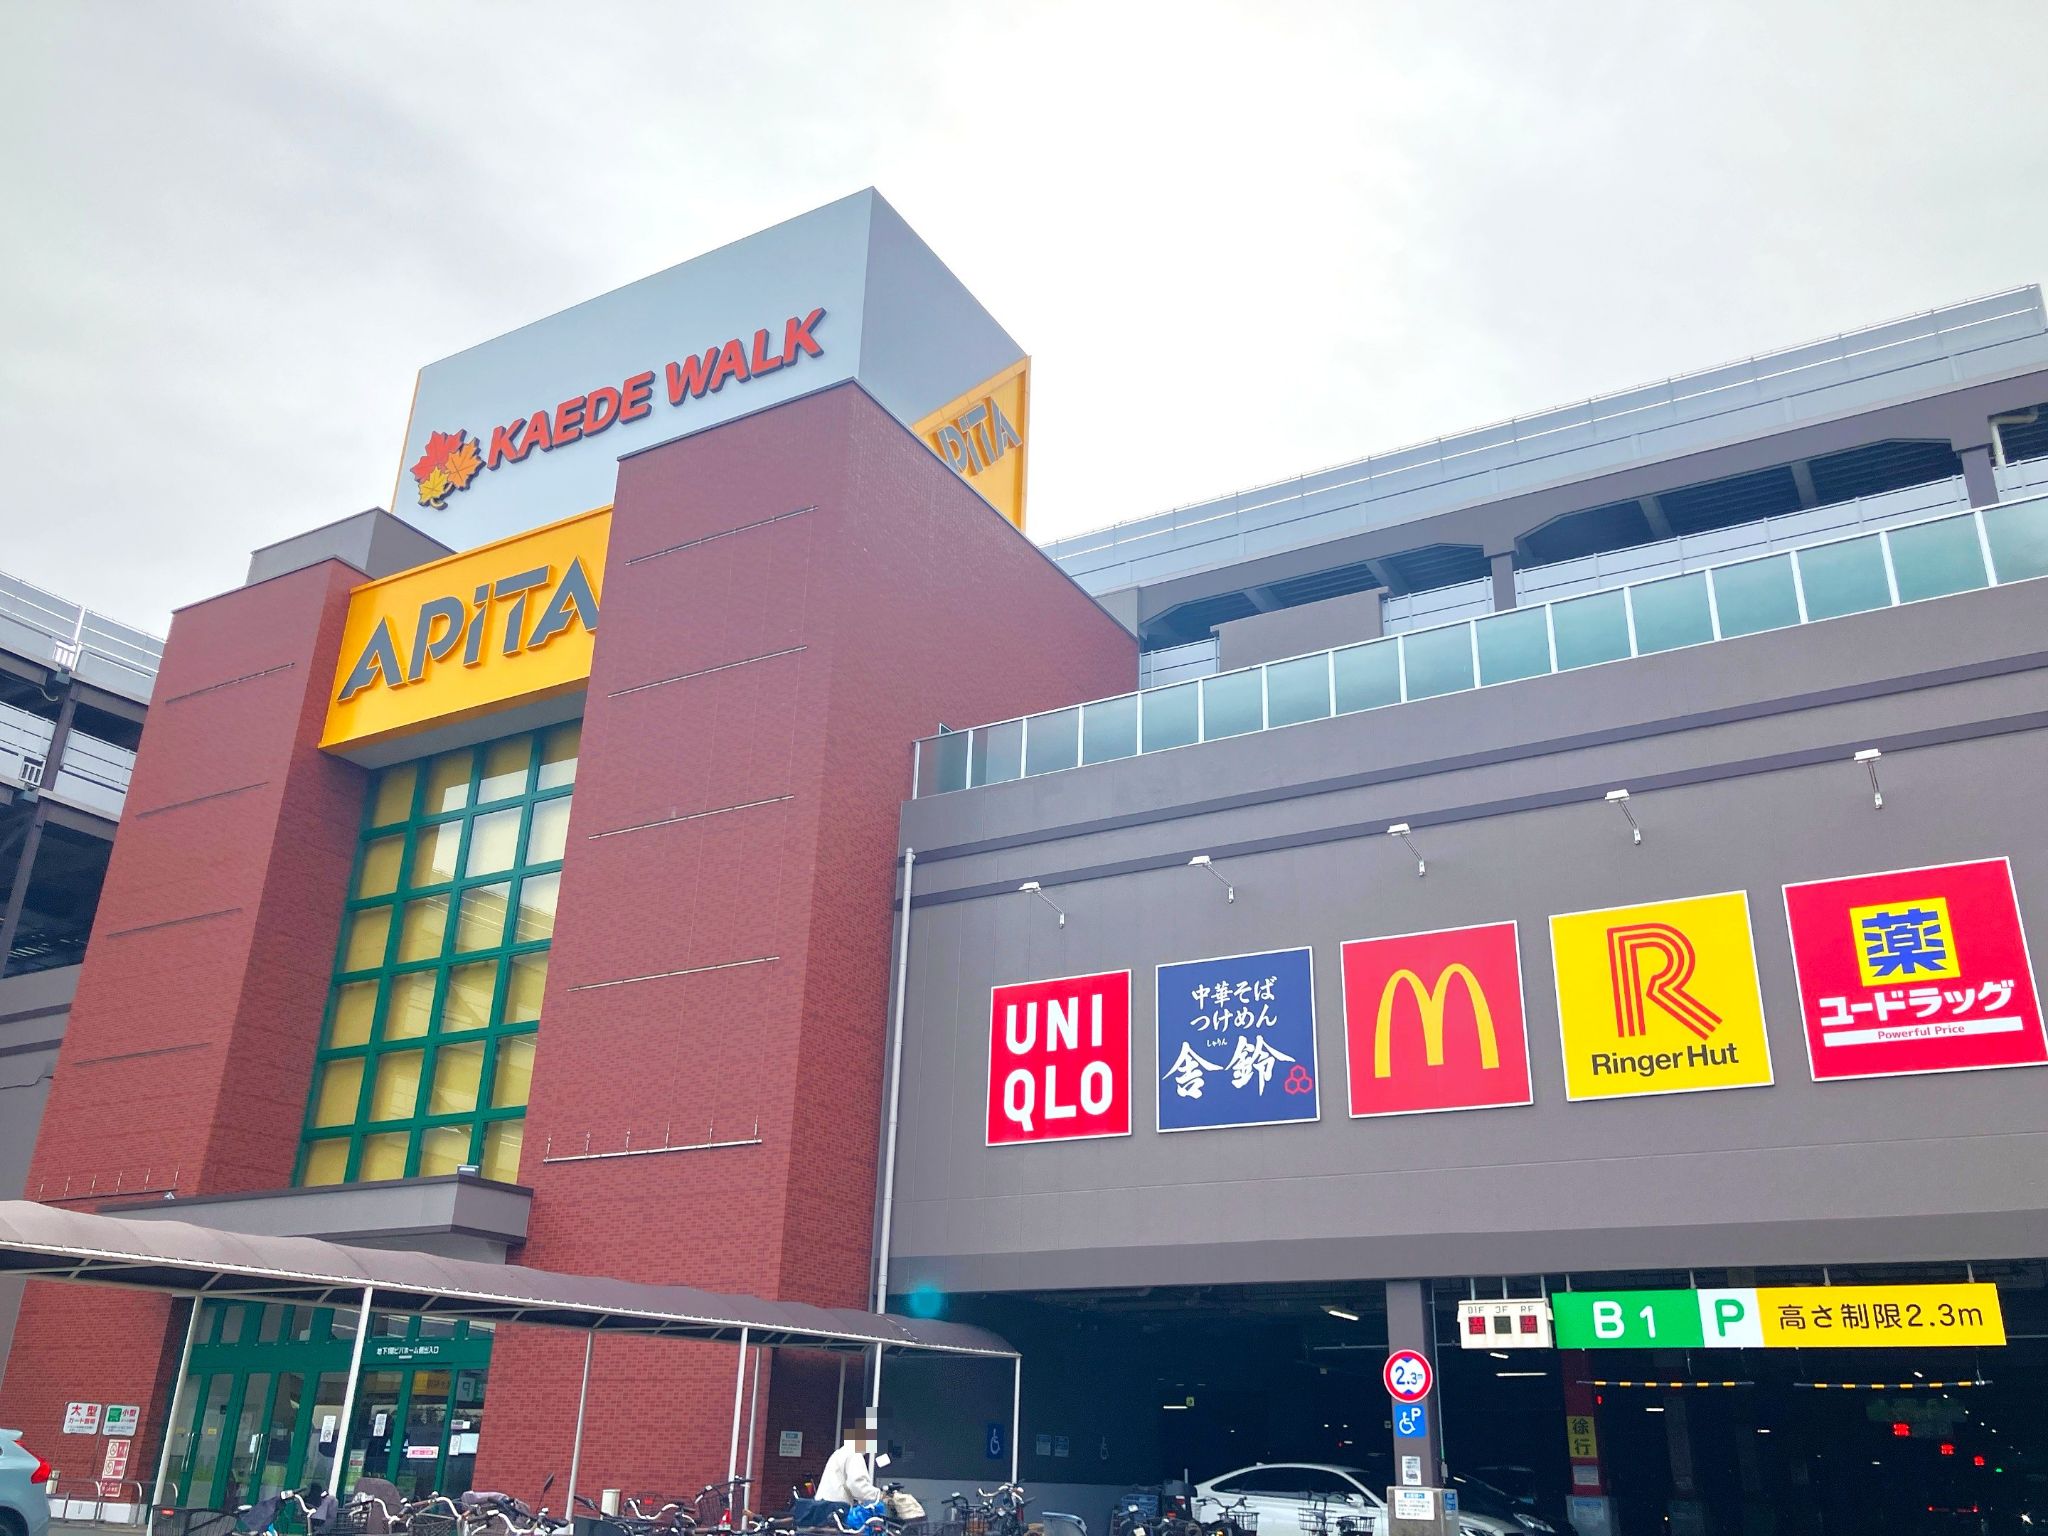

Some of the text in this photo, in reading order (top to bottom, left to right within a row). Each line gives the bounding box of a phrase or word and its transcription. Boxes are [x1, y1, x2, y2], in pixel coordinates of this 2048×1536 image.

[487, 307, 826, 471] KAEDE WALK
[1861, 908, 1947, 977] 薬
[1191, 976, 1277, 1010] 中華そば
[1819, 980, 2014, 1026] ユードラッグ
[1005, 993, 1102, 1055] UNI
[1190, 1003, 1277, 1032] つけめん
[1878, 1025, 1965, 1040] Powerful Price
[1206, 1038, 1228, 1047] しゃりん
[1592, 1043, 1738, 1078] Ringer Hut
[1003, 1060, 1114, 1132] QLO
[1715, 1299, 1744, 1337] P
[1778, 1303, 1983, 1330] 高さ制限2.3m
[1411, 1407, 1421, 1421] P
[1572, 1418, 1591, 1455] 徐行
